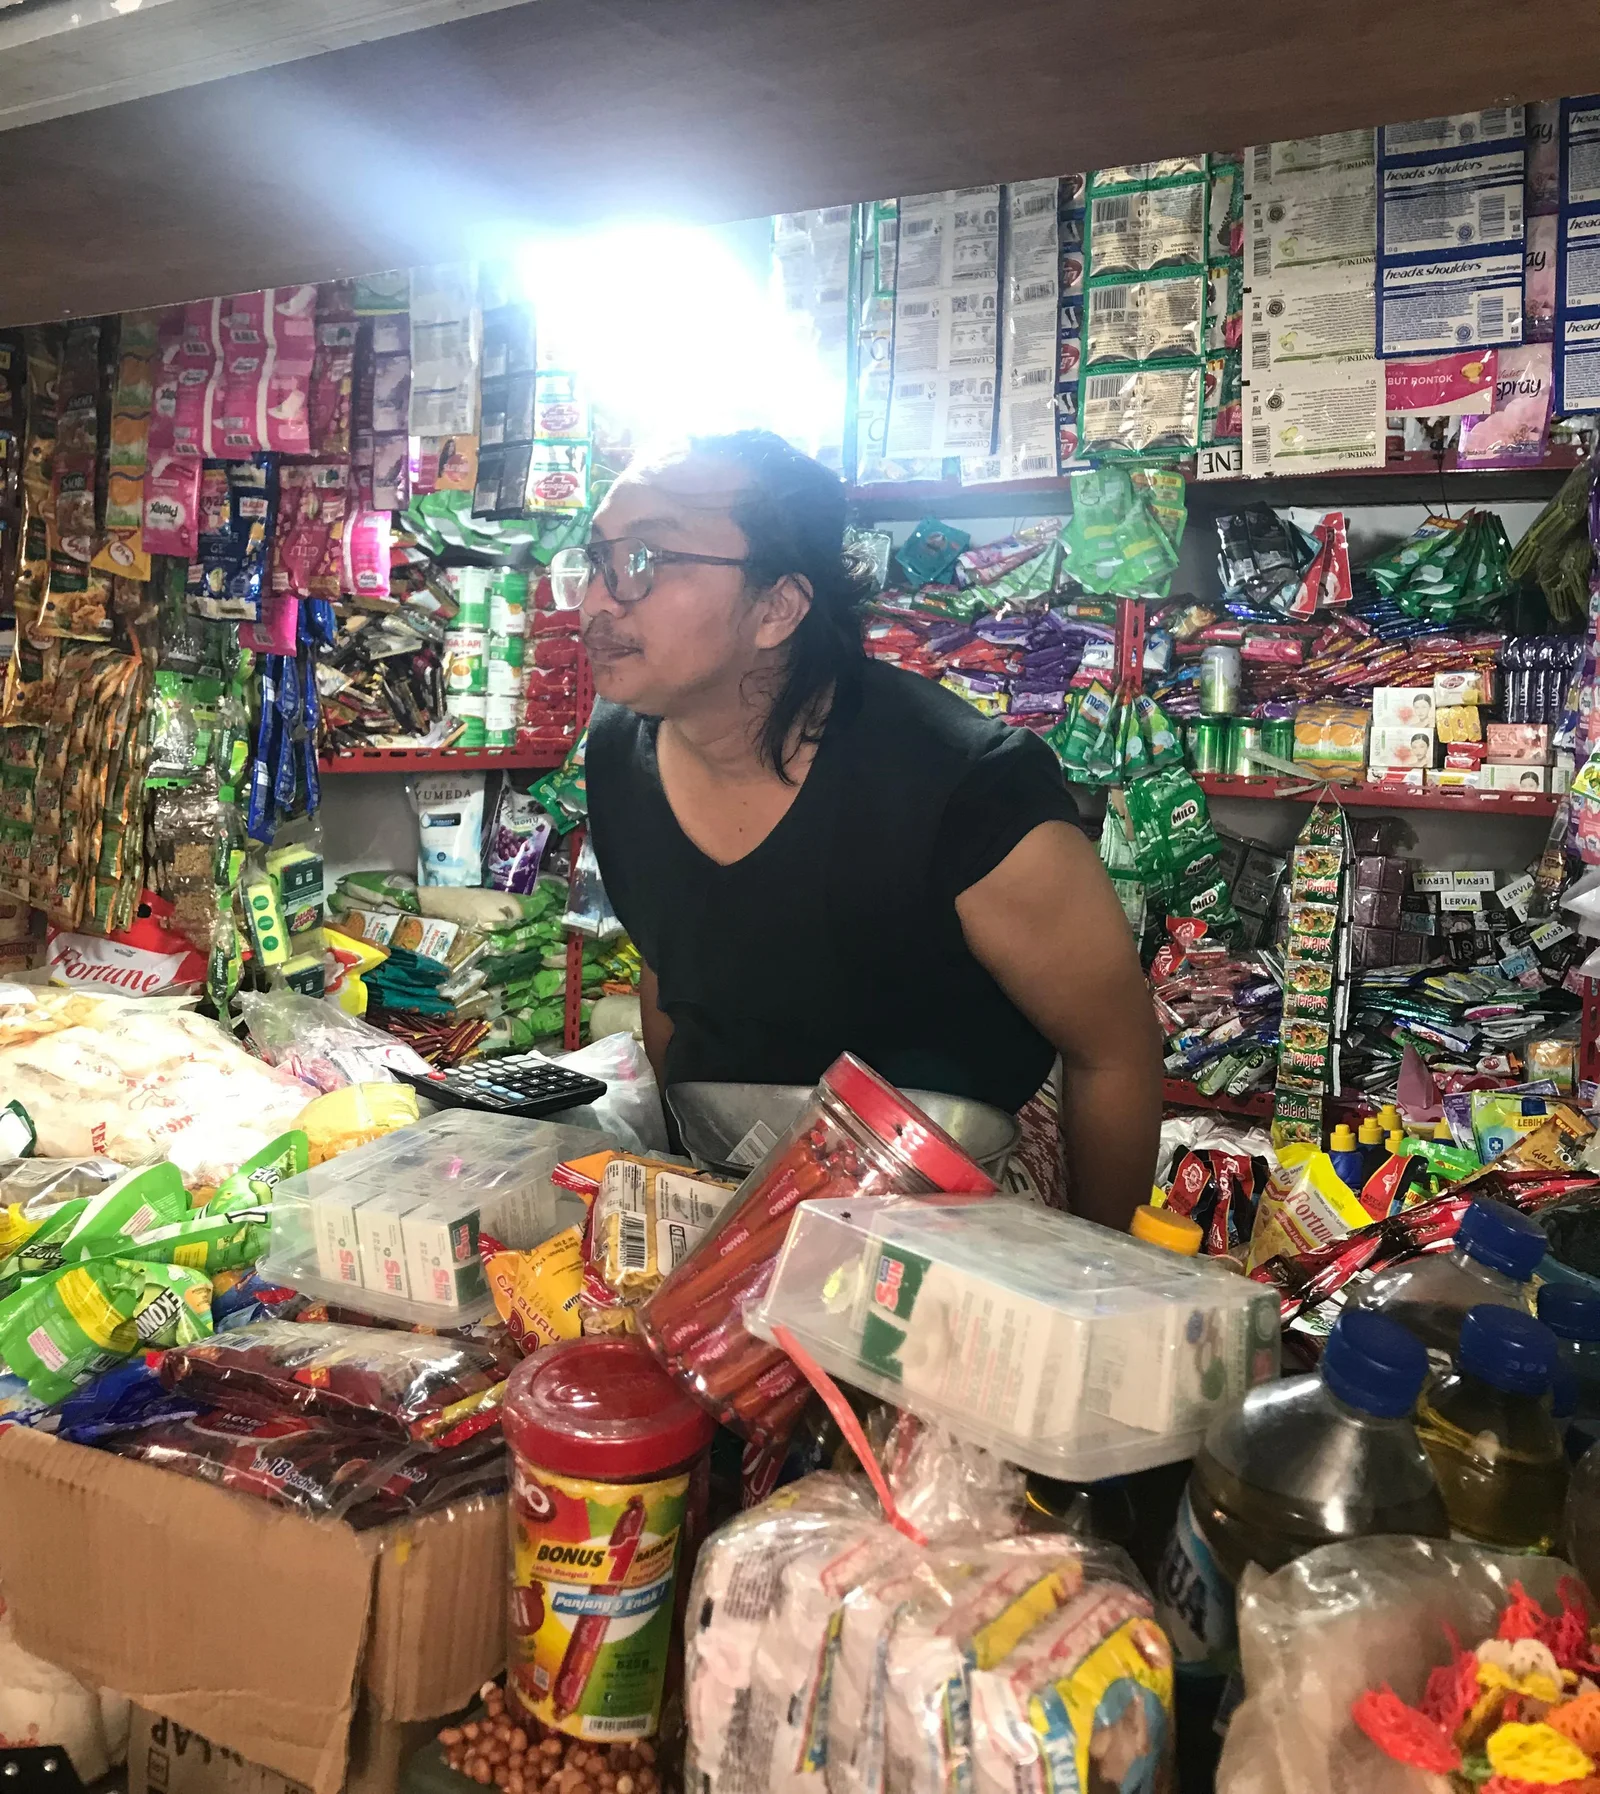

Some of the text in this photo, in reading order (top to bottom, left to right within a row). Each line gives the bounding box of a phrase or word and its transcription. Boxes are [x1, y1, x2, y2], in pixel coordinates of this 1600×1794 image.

[1387, 375, 1453, 386] BUT RONTOK
[415, 789, 471, 801] YUMEDA
[1172, 806, 1196, 824] MILO
[1417, 877, 1450, 885] LERVIA
[1457, 877, 1490, 885] LERVIA
[1503, 882, 1534, 902] LERVIA
[1192, 894, 1216, 912] MILO
[50, 946, 160, 992] Fortune
[1276, 1103, 1308, 1120] selera
[720, 1229, 749, 1257] KIMBO
[876, 1259, 906, 1311] SUN
[268, 1456, 287, 1479] 18
[536, 1544, 606, 1567] BONUS
[607, 1537, 640, 1583] 1
[555, 1591, 611, 1612] Panjang
[625, 1589, 660, 1609] Enak
